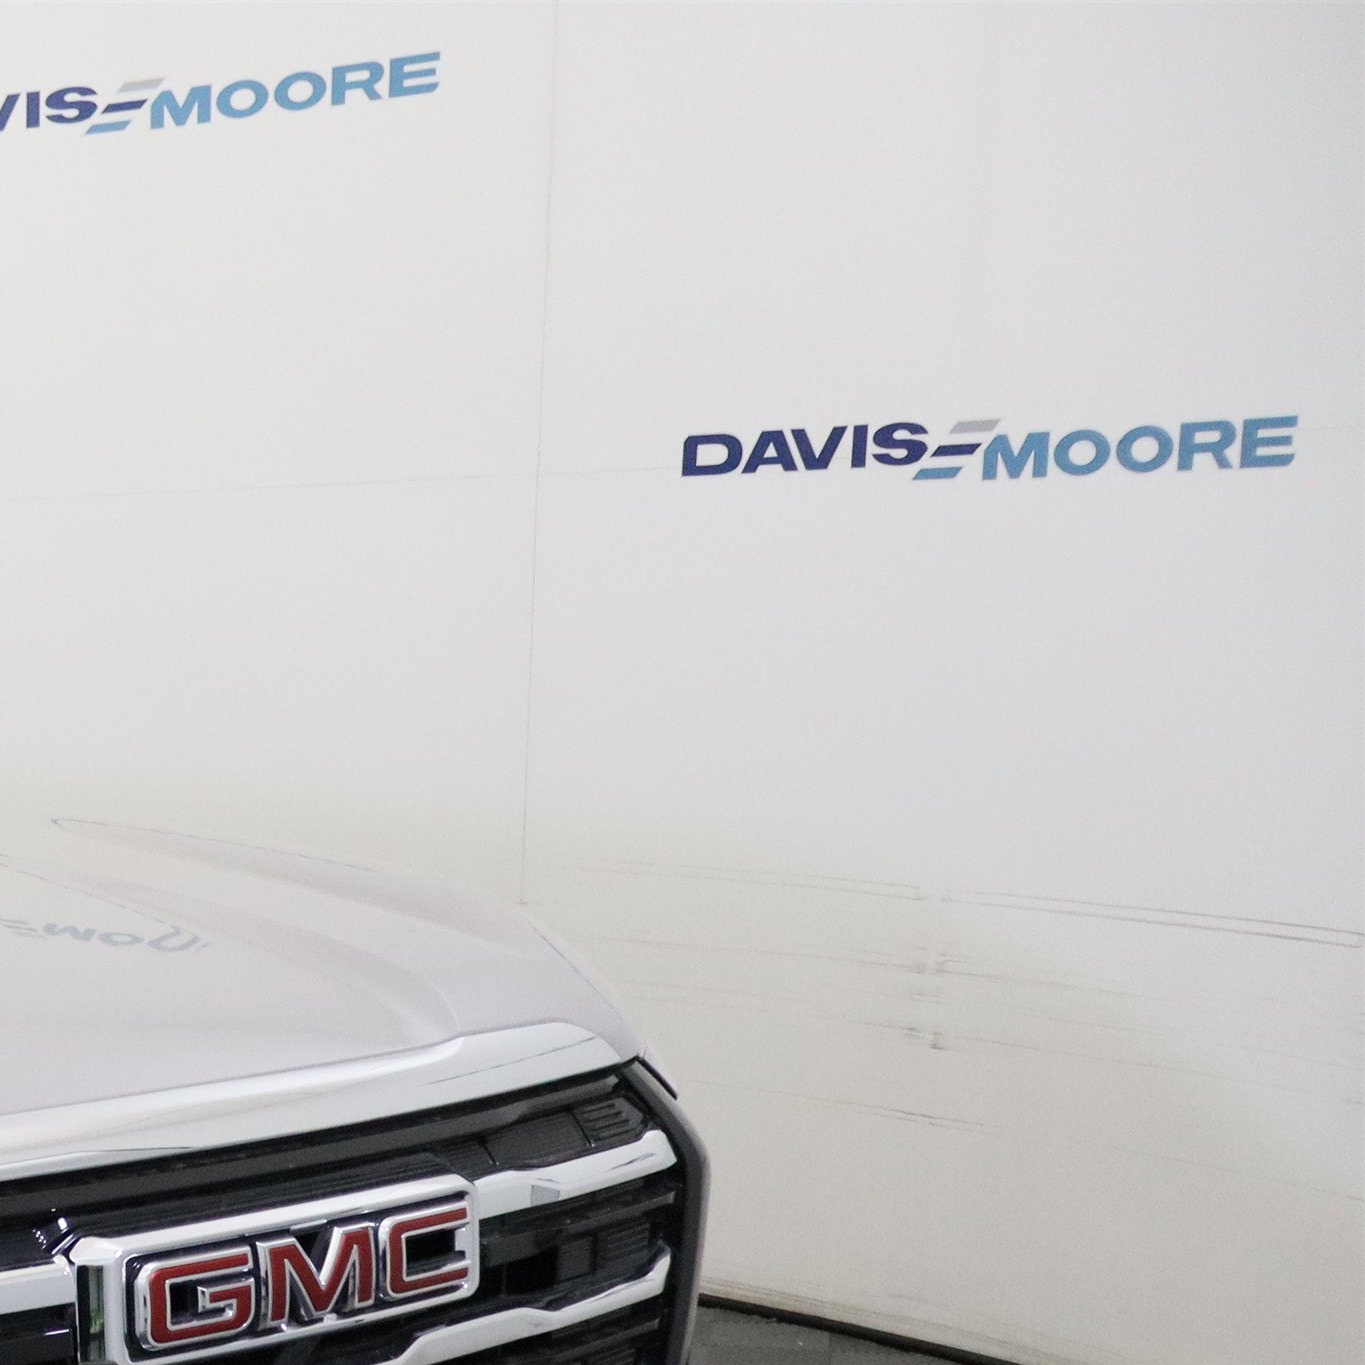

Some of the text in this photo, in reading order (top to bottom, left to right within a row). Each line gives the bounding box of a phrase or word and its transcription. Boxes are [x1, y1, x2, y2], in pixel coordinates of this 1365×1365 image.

[149, 50, 442, 131] MOORE
[680, 413, 1300, 482] DAVIS MOORE
[136, 1203, 469, 1350] GMC
